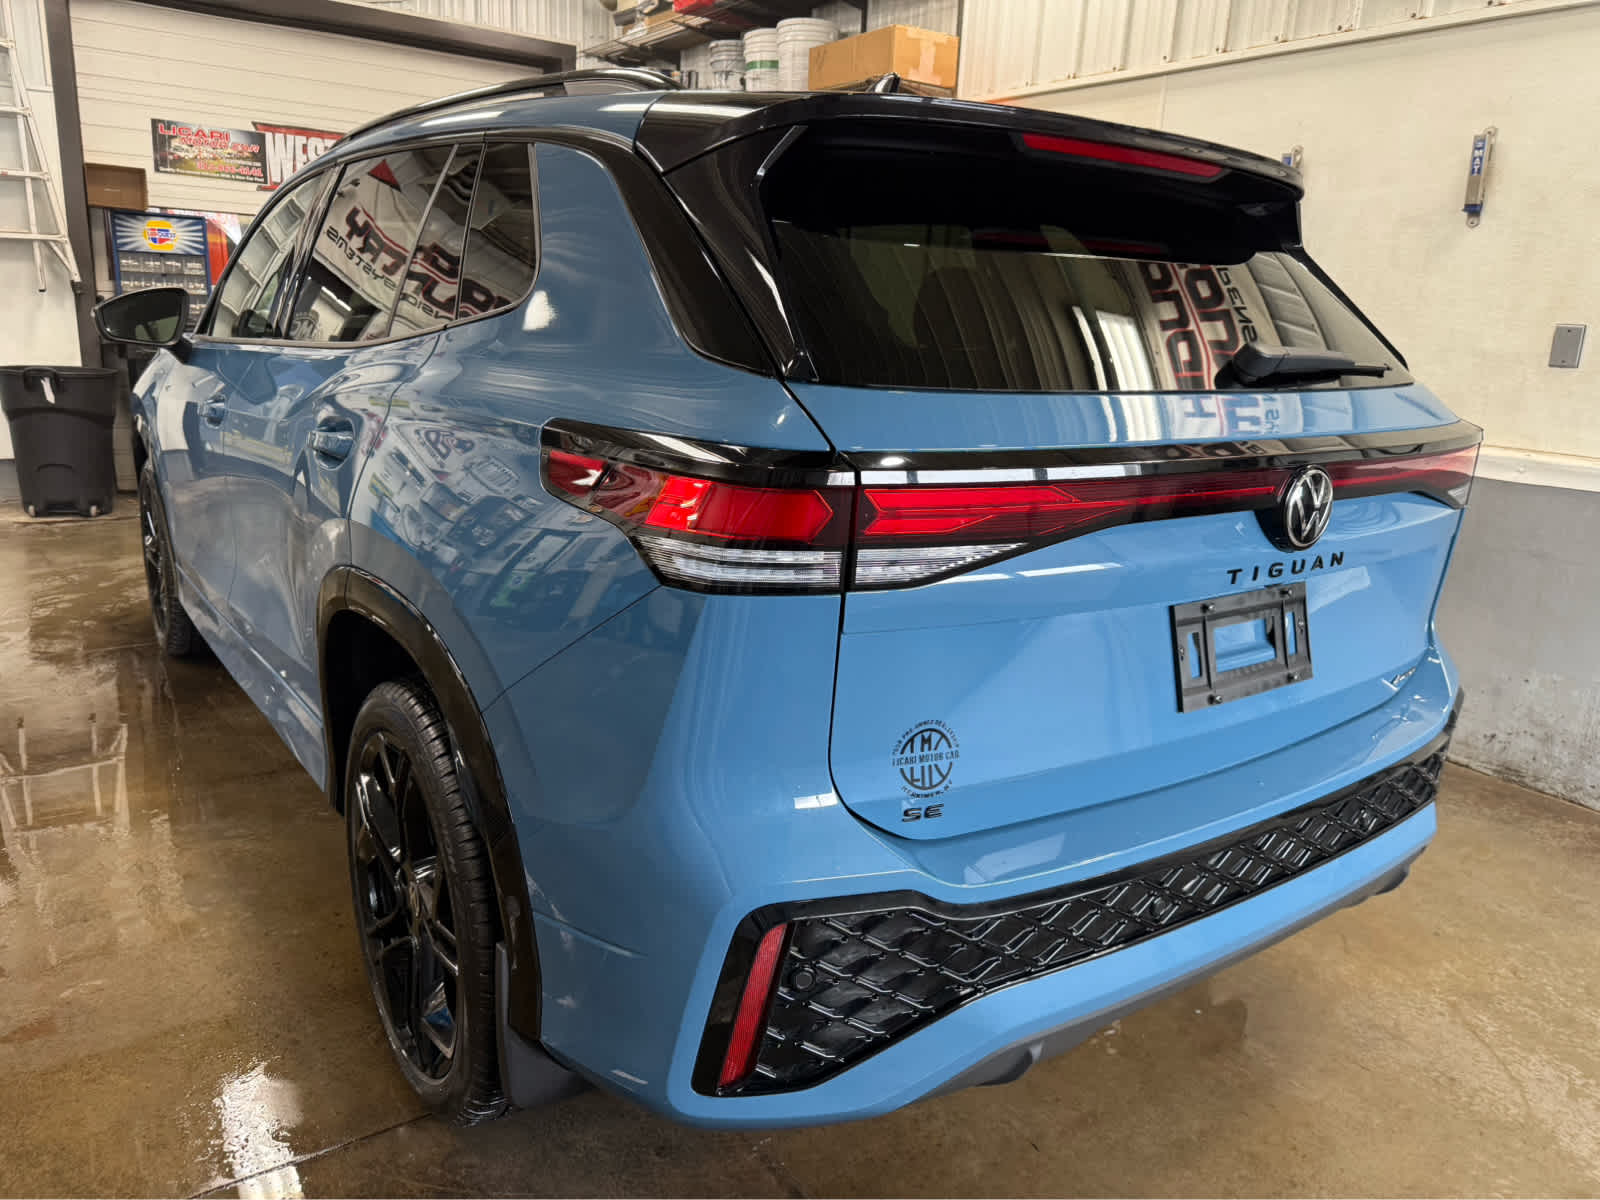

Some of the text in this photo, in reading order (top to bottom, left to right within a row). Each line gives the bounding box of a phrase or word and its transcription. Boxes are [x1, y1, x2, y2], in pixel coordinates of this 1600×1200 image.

[158, 123, 231, 142] LICARI
[1227, 551, 1345, 585] TIGUAN
[901, 803, 945, 823] SE
